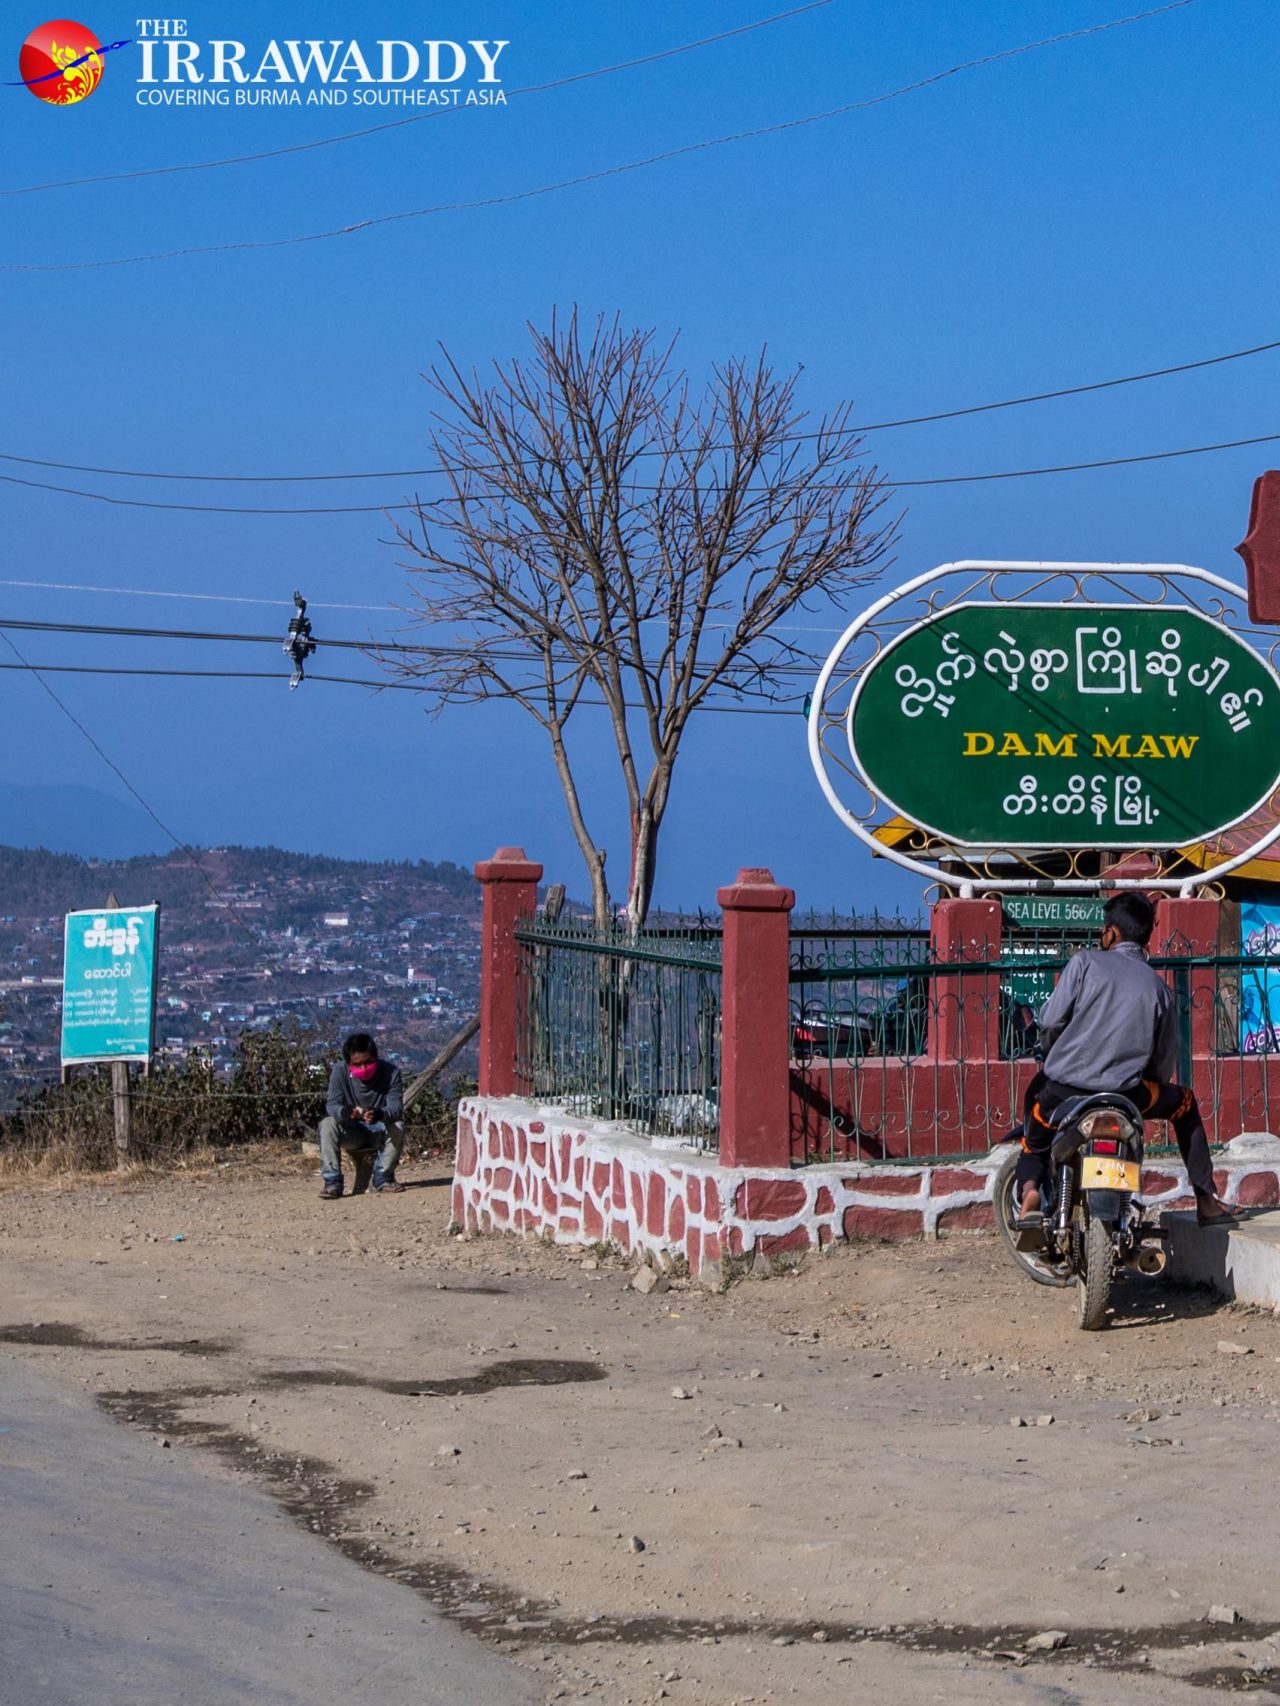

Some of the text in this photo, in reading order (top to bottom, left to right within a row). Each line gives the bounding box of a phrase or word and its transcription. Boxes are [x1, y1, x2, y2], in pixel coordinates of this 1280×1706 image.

[962, 732, 1199, 758] DAM MAW
[1007, 902, 1030, 919] SEA
[1032, 903, 1062, 919] LEVEL
[1096, 1160, 1125, 1172] CHN
